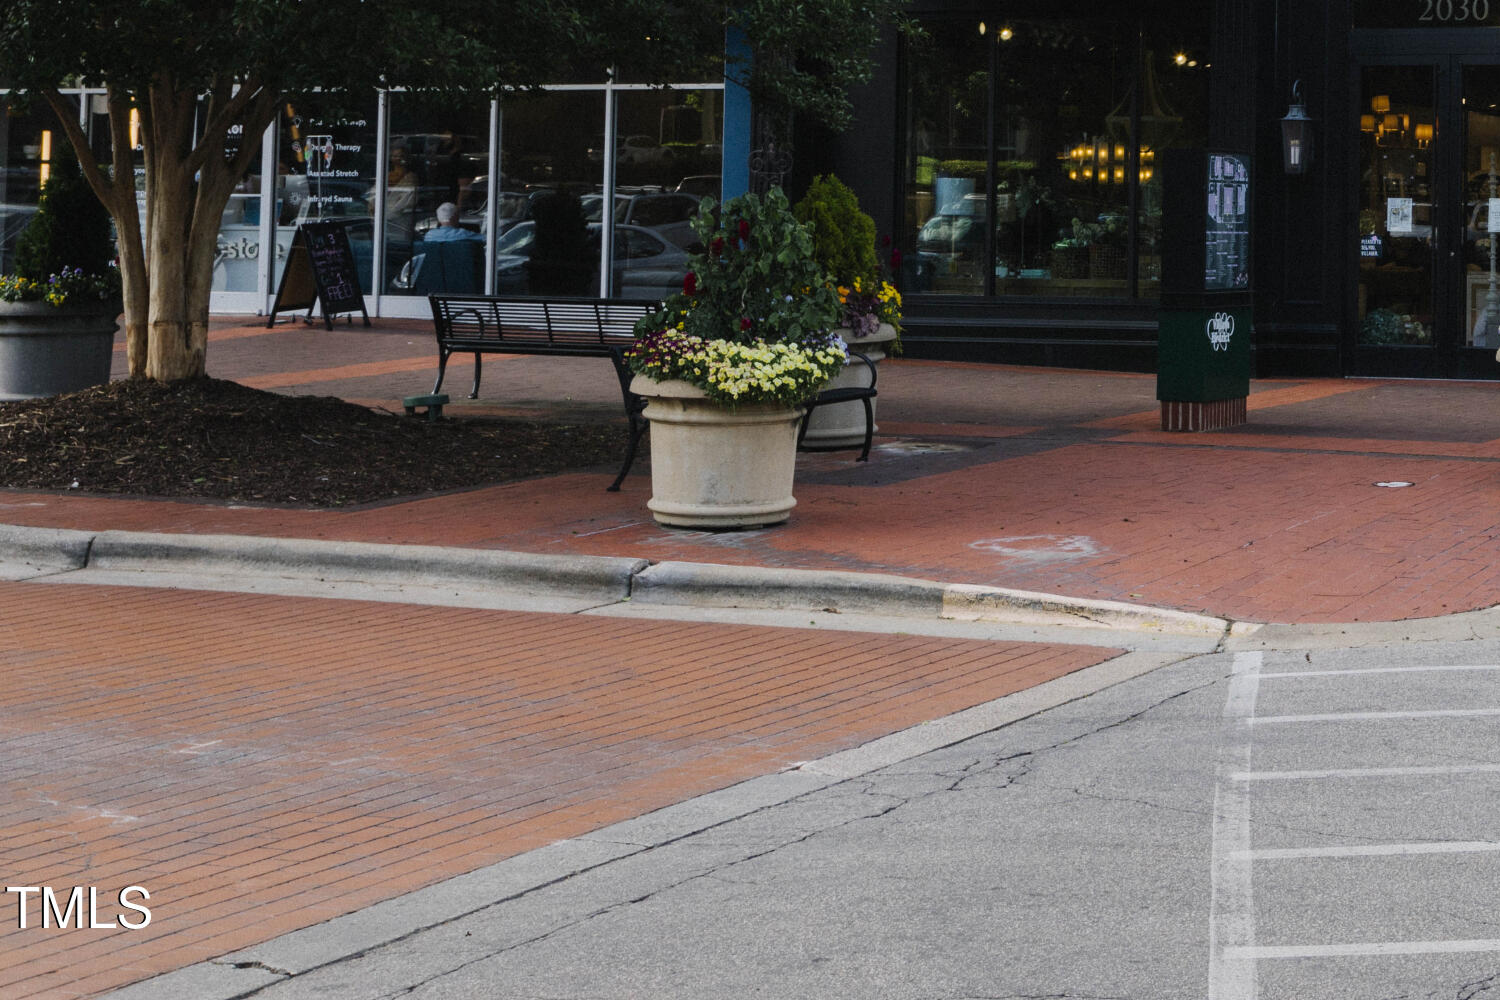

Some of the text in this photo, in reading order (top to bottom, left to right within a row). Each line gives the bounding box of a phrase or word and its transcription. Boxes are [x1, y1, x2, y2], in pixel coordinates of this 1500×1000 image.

[335, 143, 361, 153] Therapy
[335, 169, 359, 177] Stretch
[333, 195, 352, 203] Sauna
